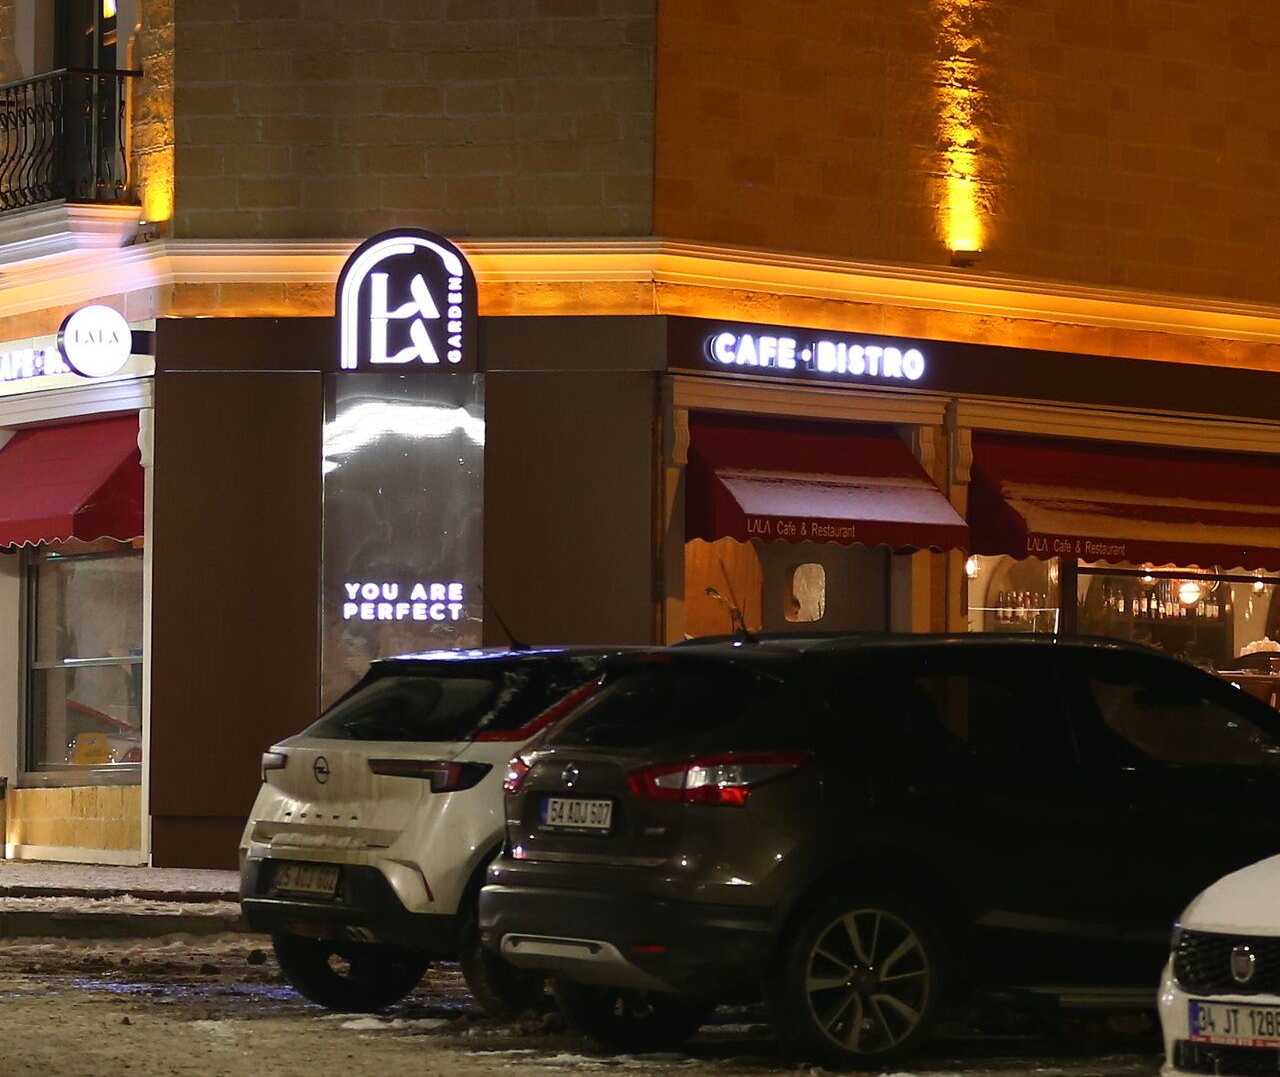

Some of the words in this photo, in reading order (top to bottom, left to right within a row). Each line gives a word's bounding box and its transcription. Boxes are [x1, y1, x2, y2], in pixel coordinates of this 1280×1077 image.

[447, 276, 462, 364] GARDEN
[713, 332, 797, 370] CAFE
[817, 341, 925, 381] BISTRO
[777, 521, 797, 535] Cafe
[801, 522, 808, 536] &
[812, 523, 856, 538] Restaurant
[1053, 539, 1072, 553] Cafe
[1075, 540, 1081, 553] &
[1085, 541, 1125, 556] Restaurant
[344, 583, 399, 601] YOU
[410, 583, 464, 601] ARE
[343, 603, 464, 621] PERFECT
[1199, 1007, 1215, 1032] 34
[1224, 1009, 1239, 1034] JT
